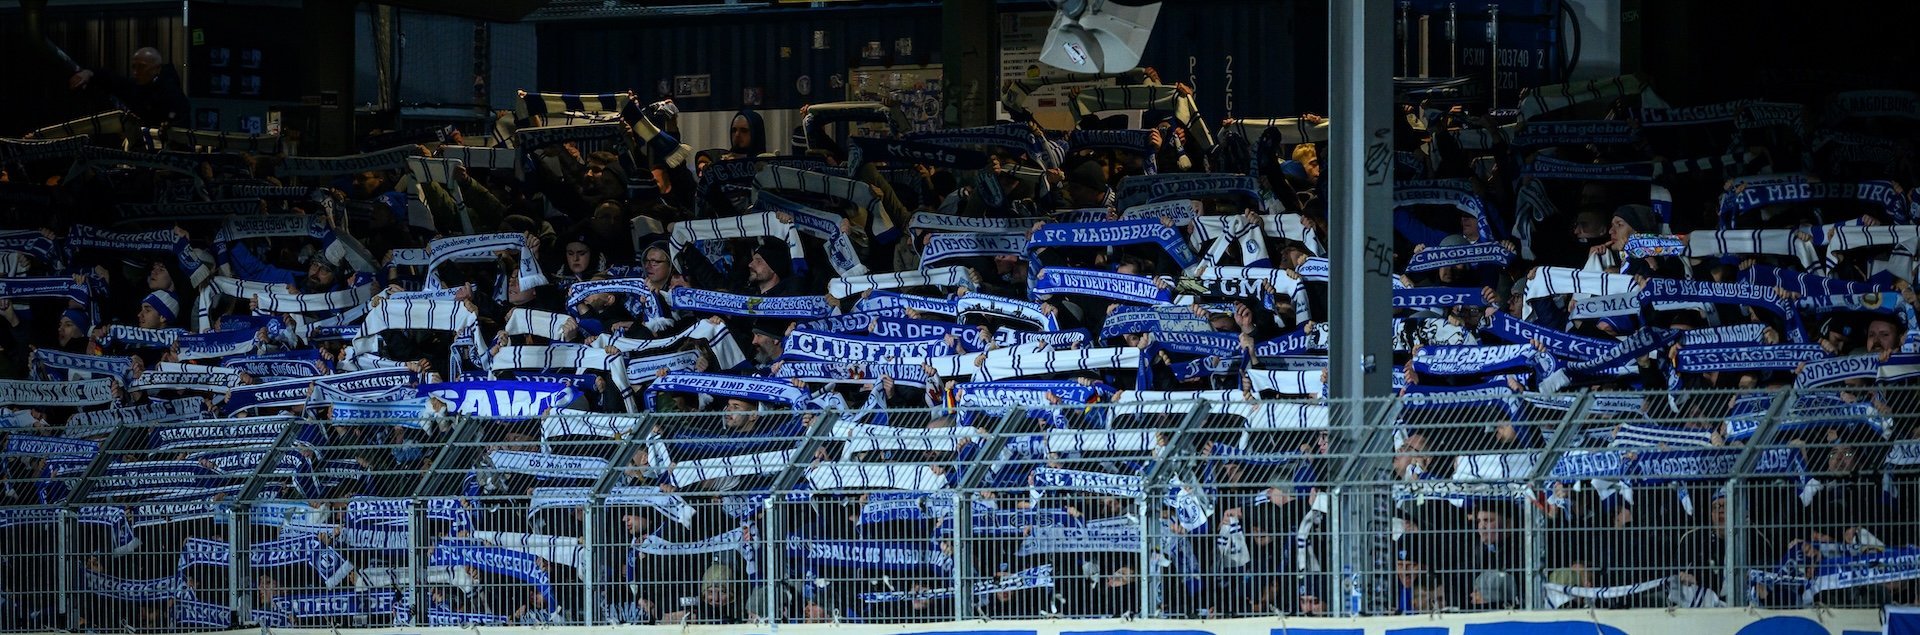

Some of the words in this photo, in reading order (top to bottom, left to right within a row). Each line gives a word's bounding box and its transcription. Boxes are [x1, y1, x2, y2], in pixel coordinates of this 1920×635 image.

[1463, 48, 1484, 66] PSXU
[1766, 182, 1897, 205] MAGDEBURG
[77, 224, 96, 238] FC
[479, 234, 490, 242] der
[1030, 233, 1041, 243] 1.
[1046, 230, 1066, 241] FC
[1072, 223, 1176, 242] MAGDEBURG
[1064, 274, 1157, 298] OSTDEUTSCHLAND
[1202, 278, 1263, 298] FCM
[1653, 279, 1677, 296] FC
[758, 299, 813, 310] MAGDEBURG
[1576, 302, 1599, 314] FC
[1504, 319, 1562, 350] Heinz
[799, 334, 929, 362] CLUBFANS
[1696, 354, 1719, 363] FC
[1722, 351, 1823, 362] MAGDEBURG
[797, 363, 824, 377] STADT
[340, 375, 410, 392] SEEHAUSEN
[661, 376, 719, 388] KÄMPFEN
[721, 380, 745, 391] UND
[749, 383, 786, 395] SIEGEN
[333, 408, 421, 419] SEEHAUSEN
